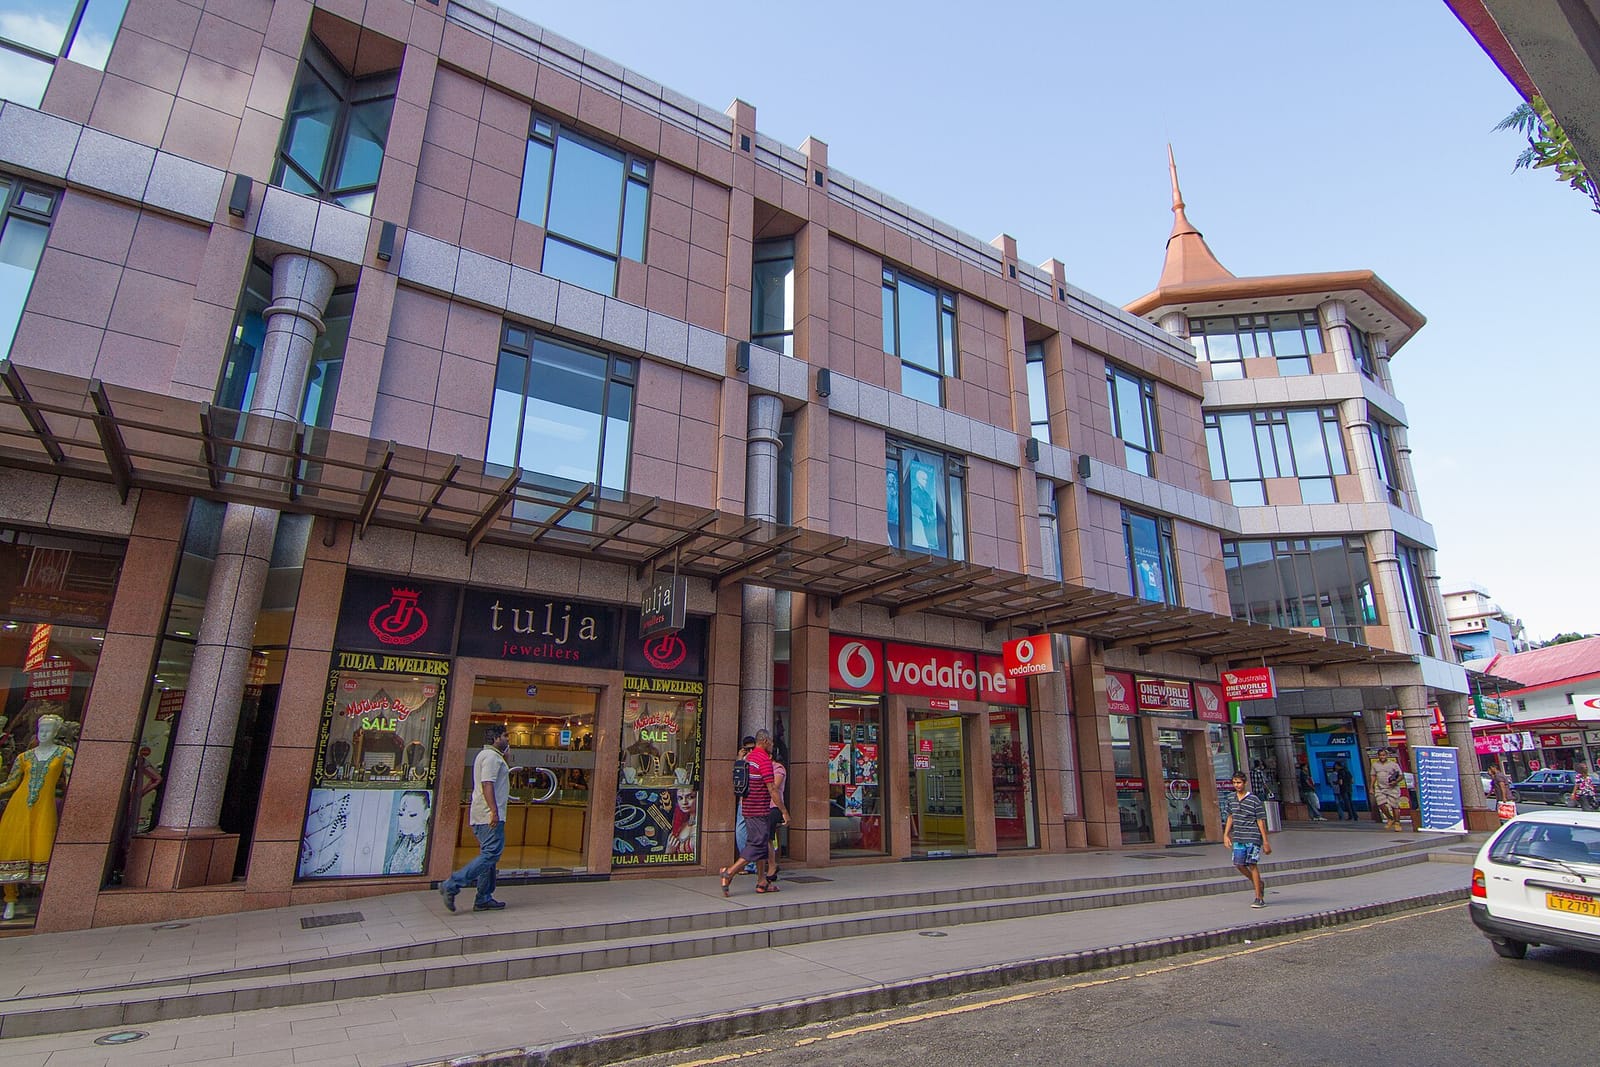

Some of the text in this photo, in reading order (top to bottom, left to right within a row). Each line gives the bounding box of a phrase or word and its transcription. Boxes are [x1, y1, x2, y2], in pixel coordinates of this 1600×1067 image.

[641, 585, 672, 617] tulja
[490, 599, 598, 644] tulja
[501, 640, 580, 661] jewellers
[42, 660, 53, 669] ALE
[338, 653, 450, 676] TULJA JEWELLERS
[1008, 662, 1047, 675] vodafone
[33, 669, 69, 679] SALE SALE
[887, 657, 1007, 693] vodafone
[33, 678, 68, 688] SALE SALE
[624, 677, 704, 694] TULJA JEWELLERS
[1140, 683, 1188, 699] ONEWORLD
[1226, 683, 1268, 692] ONEWORLD
[30, 687, 66, 698] SALE SALE
[436, 678, 448, 718] DIAMOND
[1142, 694, 1190, 708] FLIGHT CENTRE
[323, 692, 336, 718] GOLD
[345, 696, 412, 722] Mother's Day
[362, 717, 398, 732] SALE
[641, 730, 669, 743] SALE
[314, 719, 330, 785] JEWELLERY
[428, 723, 441, 785] JEWELLERY
[611, 853, 695, 865] TULJA JEWELLERS
[1550, 897, 1597, 914] LT 2797
